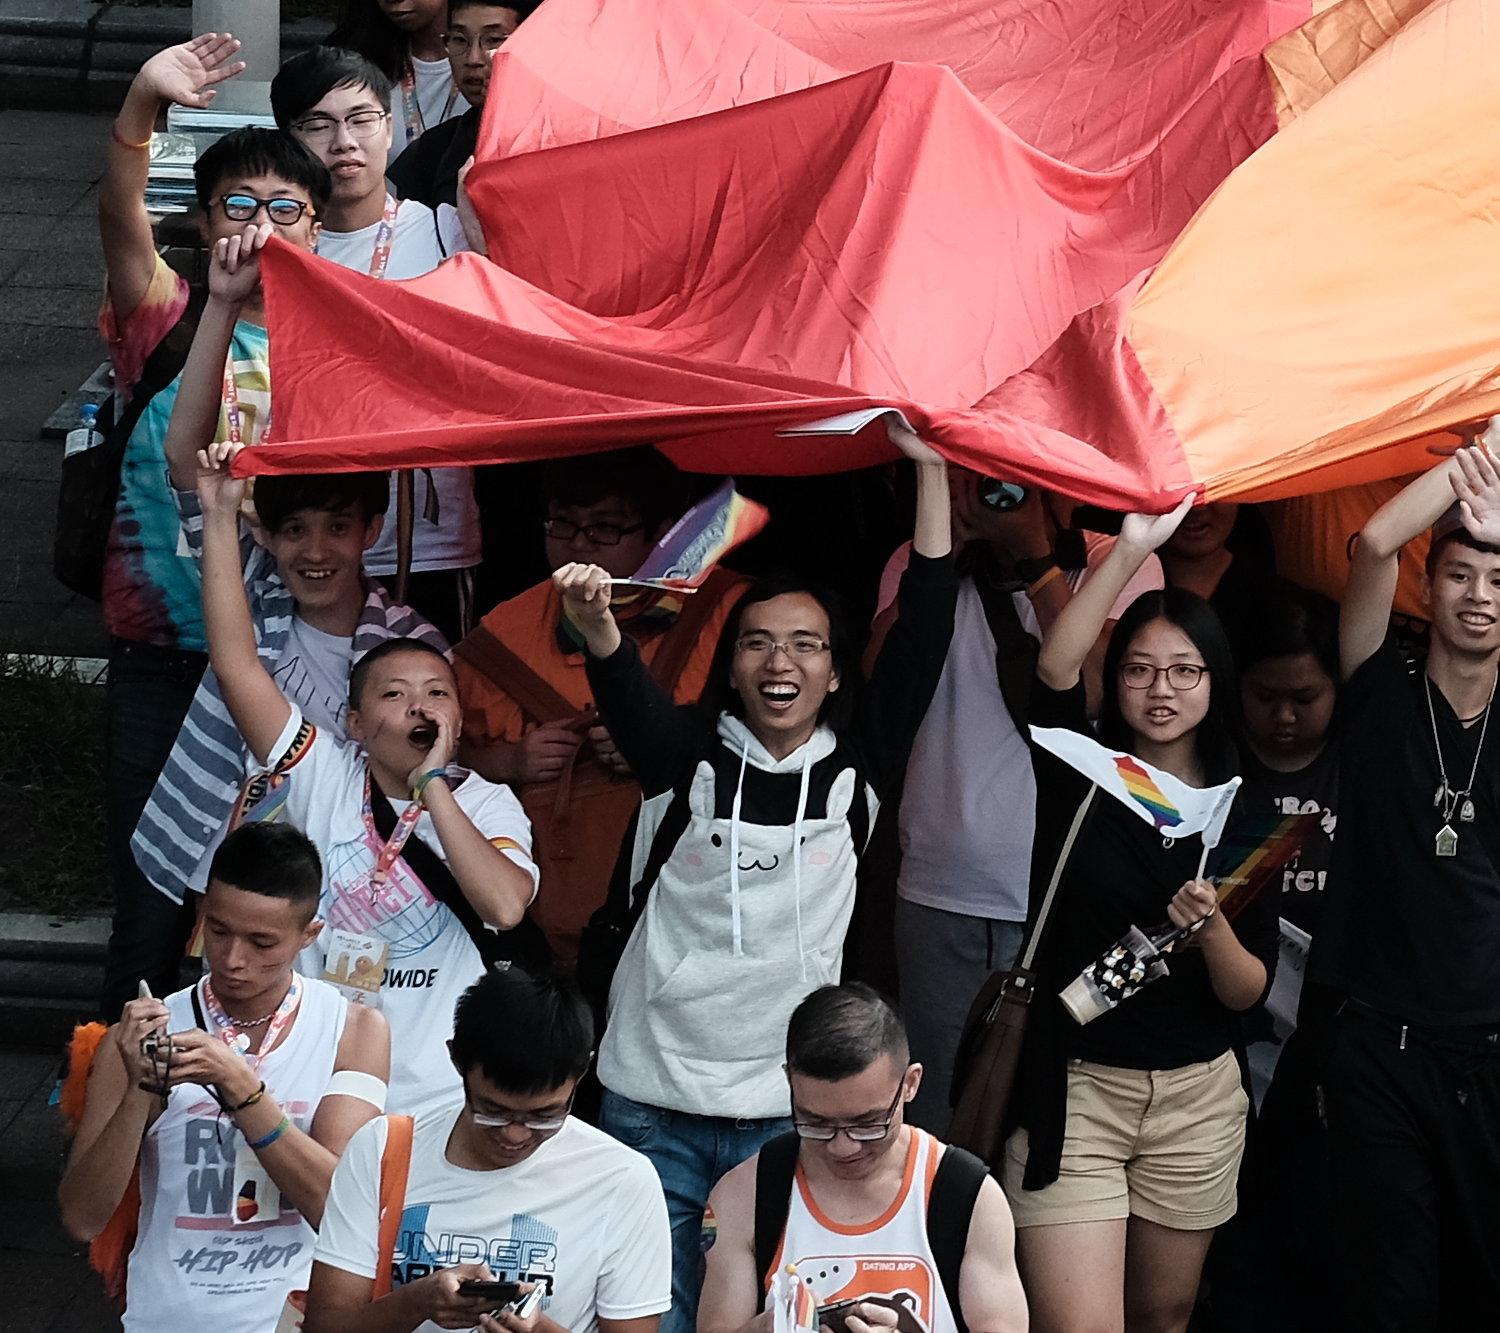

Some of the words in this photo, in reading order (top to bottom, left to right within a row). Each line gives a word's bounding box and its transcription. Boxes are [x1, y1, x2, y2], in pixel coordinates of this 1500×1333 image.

[173, 1246, 239, 1276] HIP
[239, 1242, 303, 1275] HOP
[393, 1231, 557, 1273] UNDER
[862, 1262, 895, 1271] DATING
[896, 1262, 916, 1271] APP
